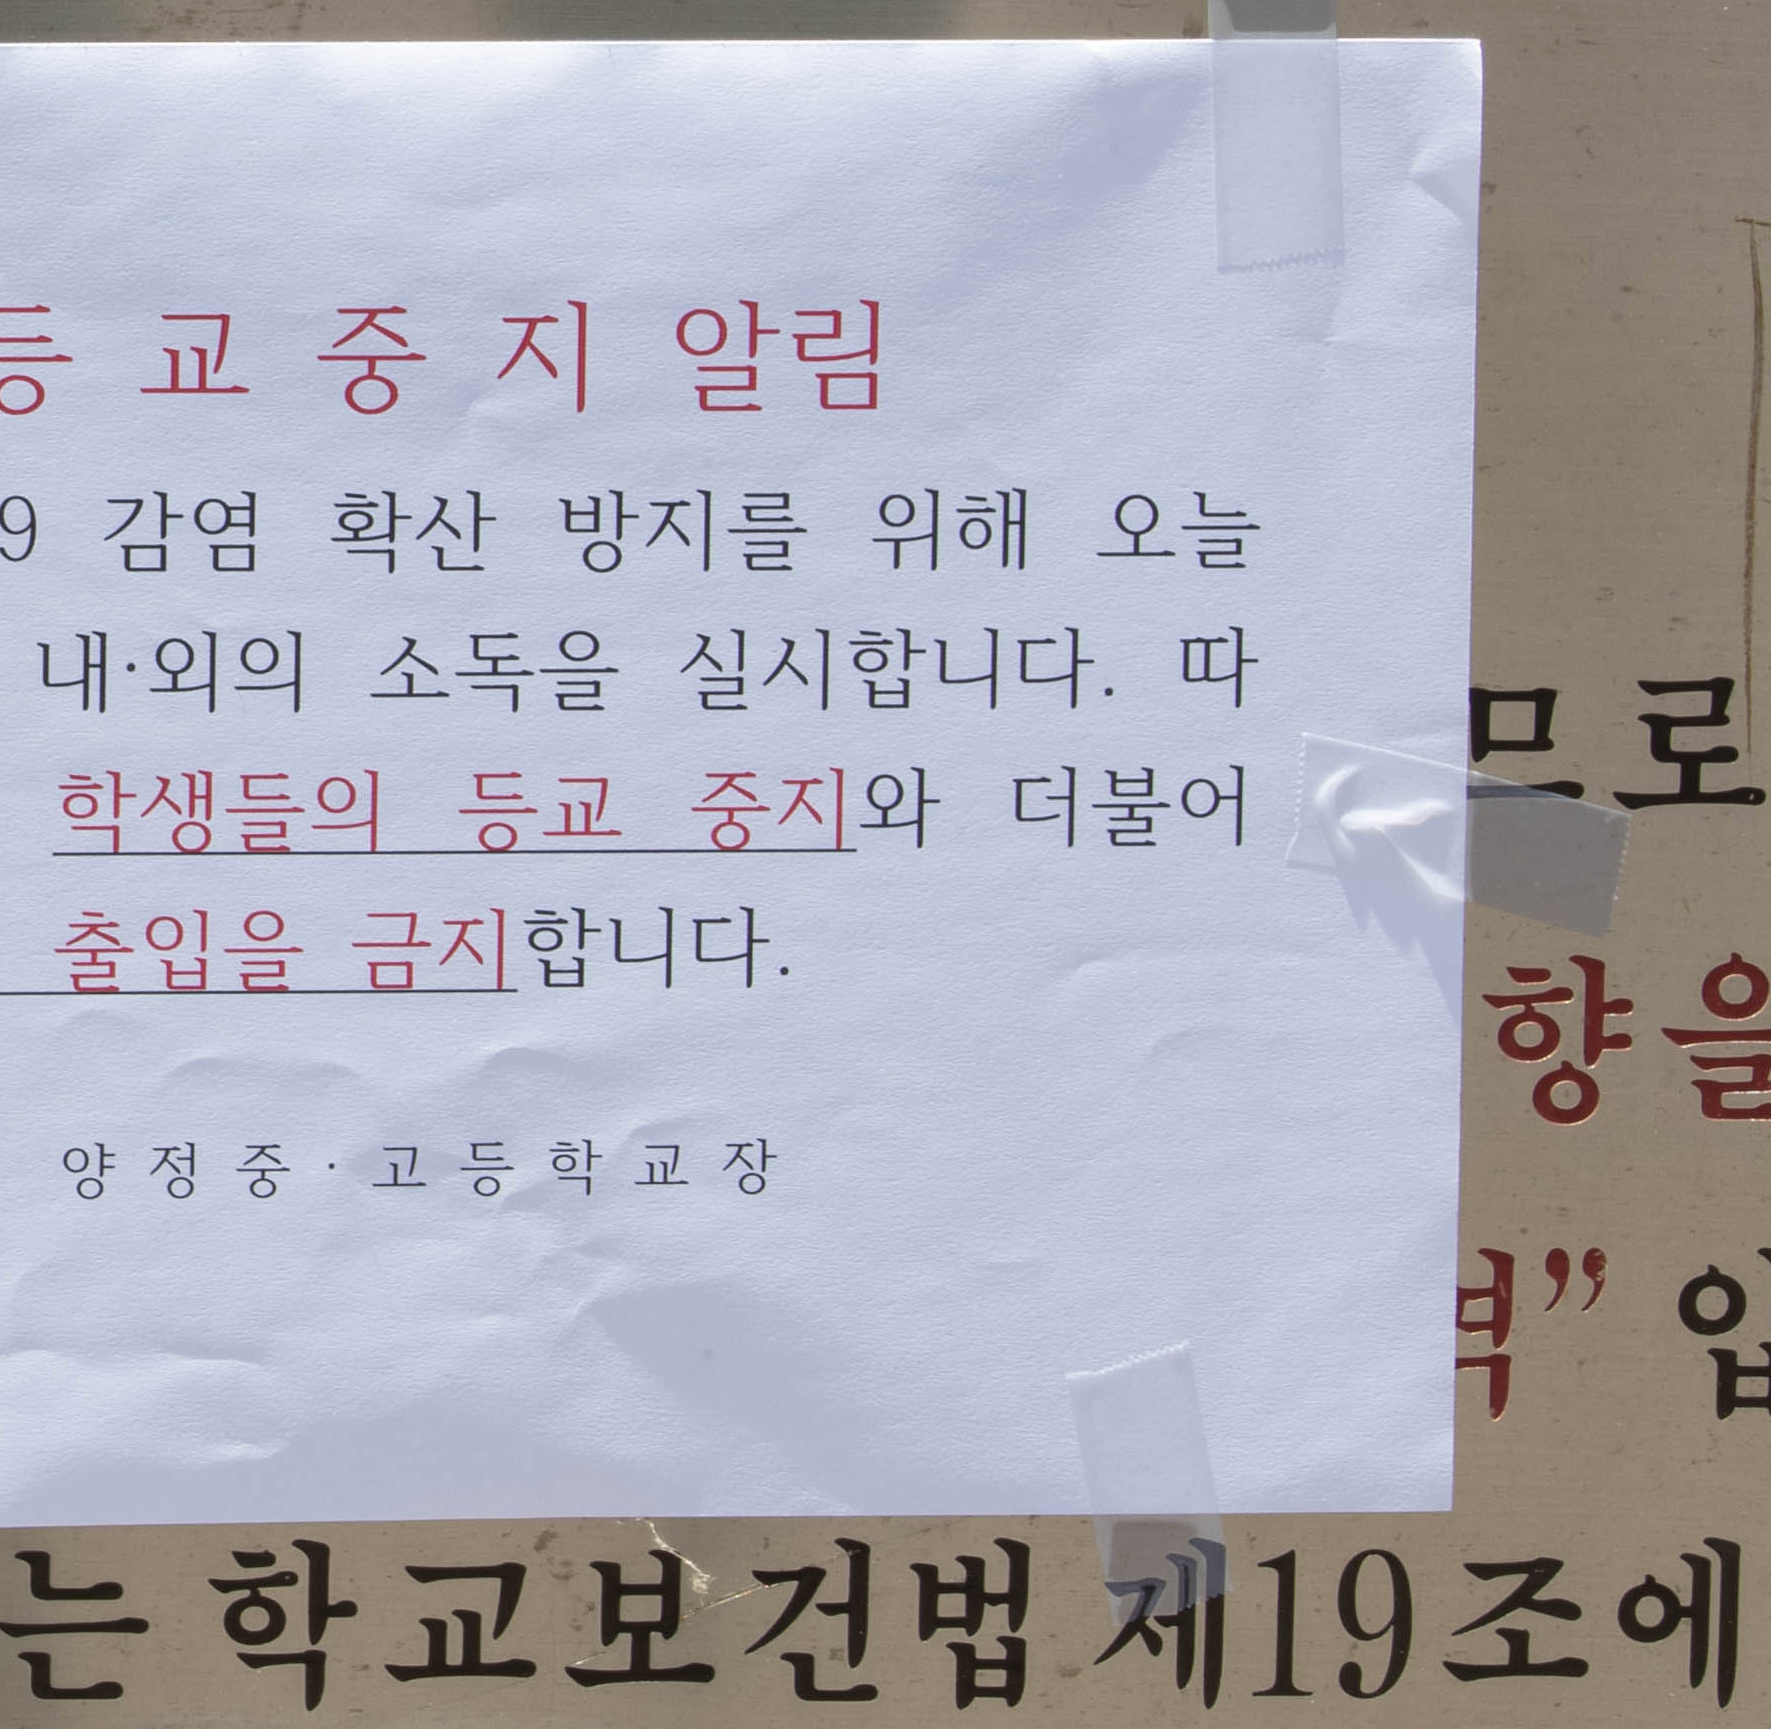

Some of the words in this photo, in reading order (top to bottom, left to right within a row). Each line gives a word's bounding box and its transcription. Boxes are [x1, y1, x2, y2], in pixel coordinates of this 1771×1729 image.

[676, 299, 883, 413] 알림
[104, 491, 259, 574] 감염
[331, 490, 497, 574] 확산
[559, 489, 809, 574] 방지를
[872, 488, 1031, 573] 위해
[1097, 491, 1263, 570] 오늘
[37, 630, 306, 714] 내·외의
[370, 631, 620, 713] 소독을
[680, 627, 1115, 712] 실시합니다.
[1180, 626, 1261, 710] 따
[57, 768, 382, 854] 학생들의
[459, 771, 624, 853] 등교
[689, 767, 941, 853] 중지와
[1013, 765, 1249, 849] 더불어
[55, 907, 303, 995] 출입을
[352, 907, 791, 993] 금지합니다.
[1482, 952, 1771, 1127] 향을
[207, 1537, 1031, 1714] 학교보건법
[1093, 1534, 1743, 1712] 제19조에
